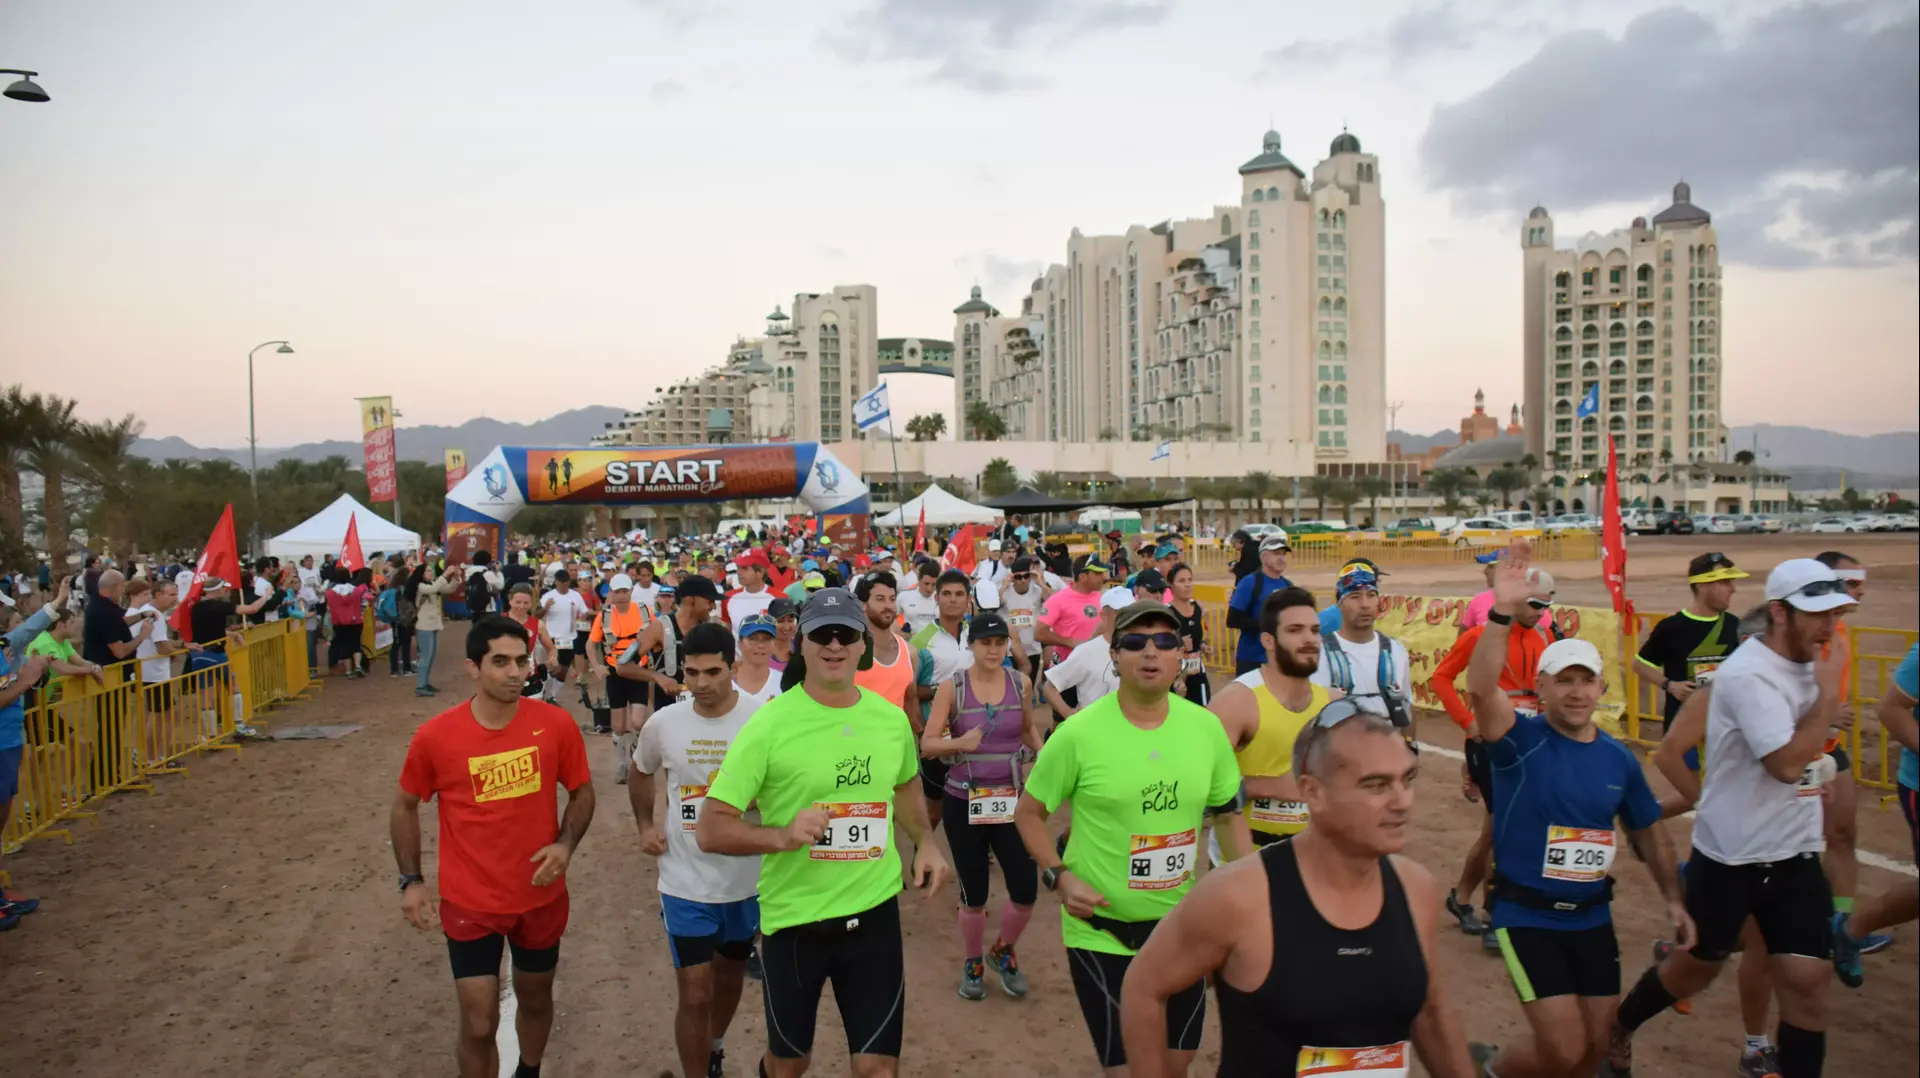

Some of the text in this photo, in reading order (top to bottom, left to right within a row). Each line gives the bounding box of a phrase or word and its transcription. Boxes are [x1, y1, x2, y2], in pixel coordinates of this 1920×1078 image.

[606, 459, 723, 485] START
[604, 485, 642, 493] DESERT
[644, 483, 698, 492] MARATHON
[479, 755, 533, 792] 2009
[991, 801, 1007, 812] 33
[848, 824, 869, 842] 91
[1166, 853, 1185, 872] 93
[1574, 849, 1605, 866] 206
